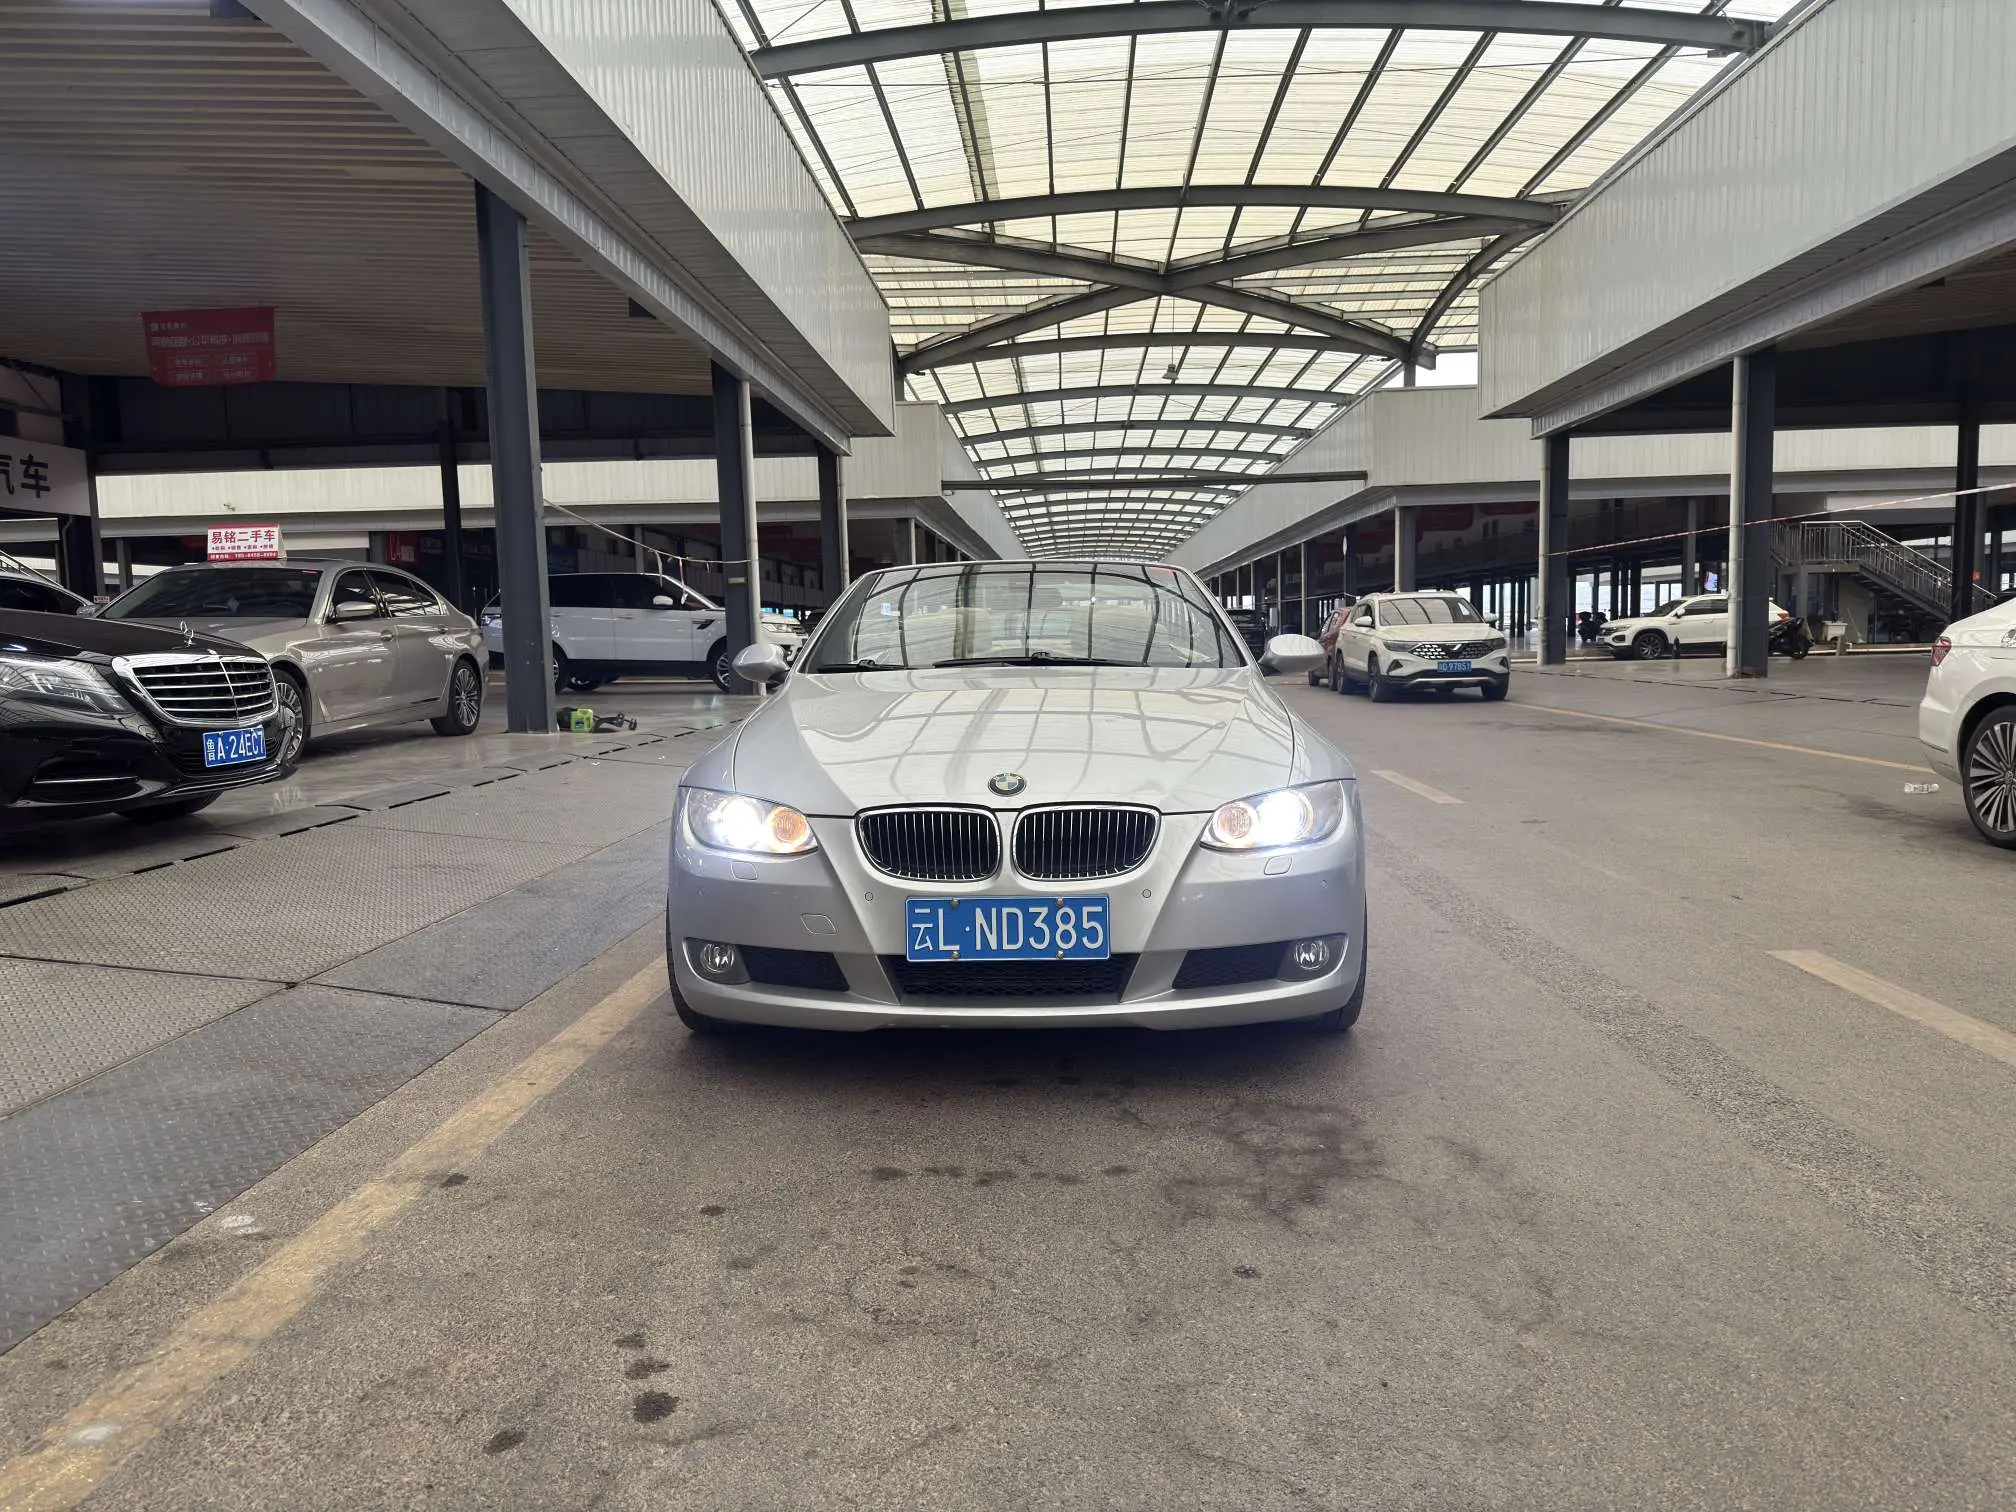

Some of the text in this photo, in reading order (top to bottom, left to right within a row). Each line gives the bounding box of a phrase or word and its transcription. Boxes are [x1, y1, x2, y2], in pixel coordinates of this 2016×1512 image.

[211, 530, 275, 544] 易铭二手车
[912, 907, 1103, 950] 云L·ND385
